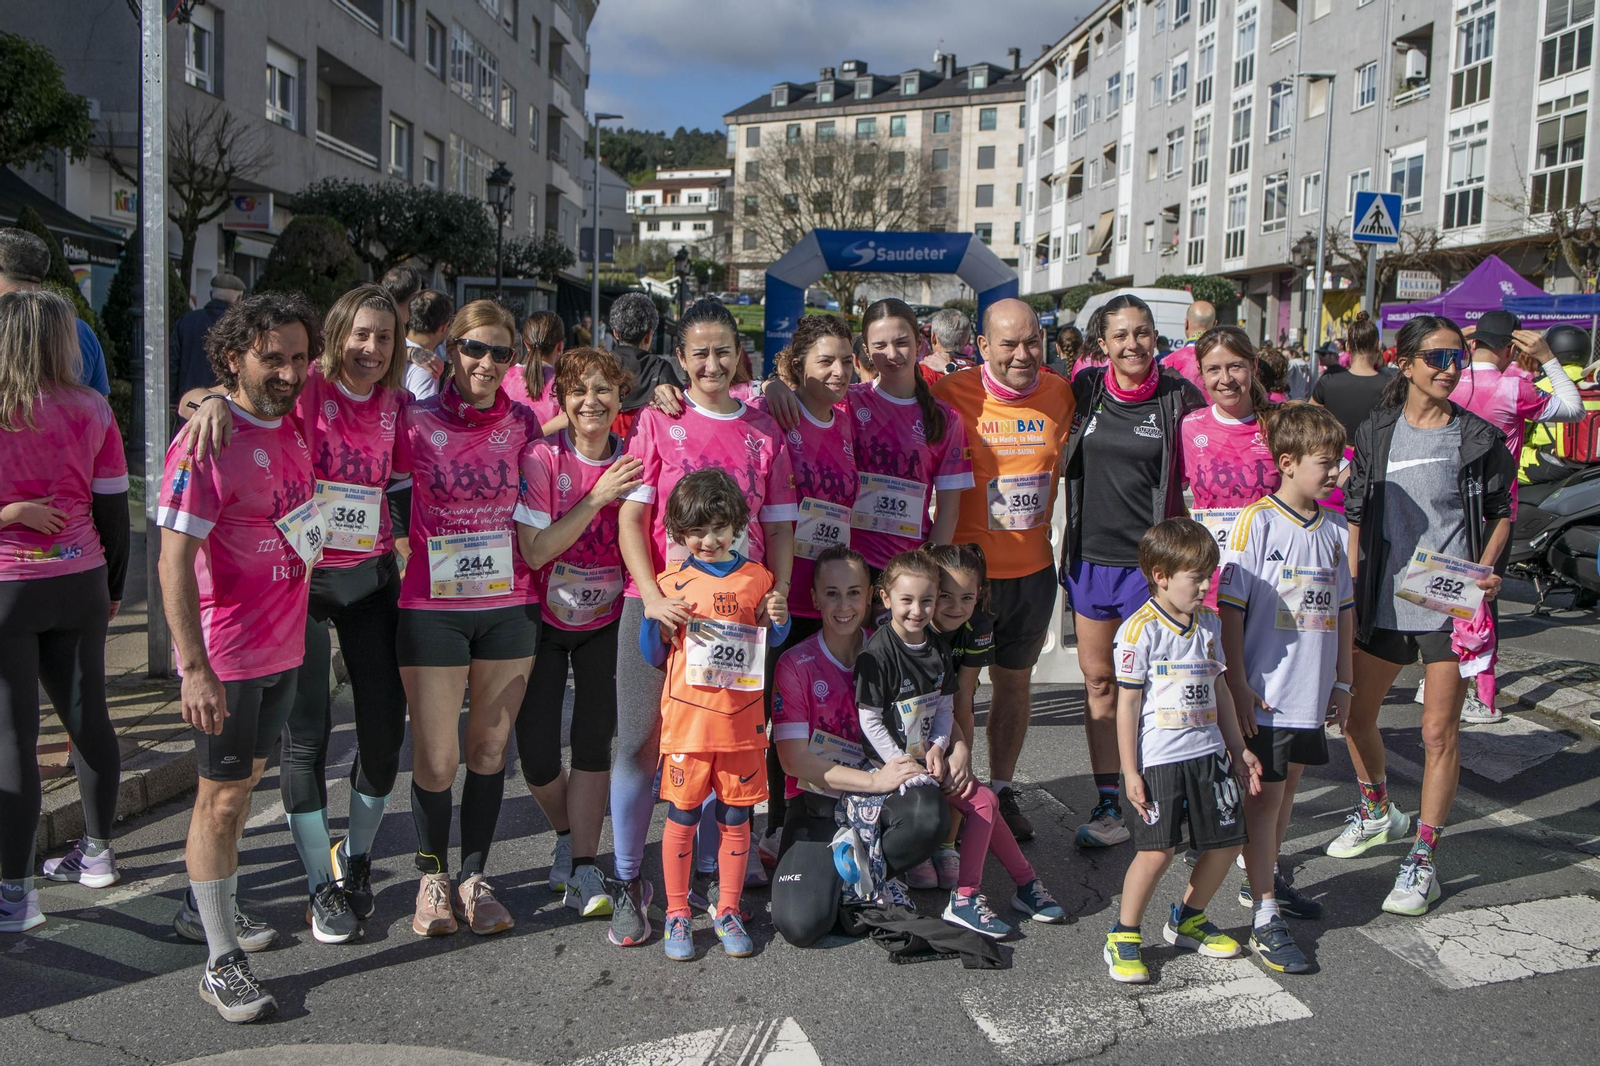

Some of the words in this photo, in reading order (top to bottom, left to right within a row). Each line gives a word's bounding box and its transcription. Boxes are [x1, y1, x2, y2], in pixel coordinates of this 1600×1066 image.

[876, 246, 947, 261] Saudeter
[766, 329, 792, 338] Saudete
[981, 419, 1045, 434] MINIBAY
[880, 496, 907, 512] 319
[1012, 493, 1039, 507] 306
[335, 507, 366, 524] 368
[440, 507, 474, 517] Carreira
[475, 504, 492, 518] pola
[495, 502, 515, 514] igual
[306, 525, 322, 546] 369
[817, 523, 840, 539] 318
[256, 538, 279, 553] III
[459, 555, 493, 572] 244
[1431, 577, 1465, 595] 252
[581, 589, 602, 602] 97
[1305, 591, 1331, 606] 360
[713, 644, 745, 663] 296
[1185, 684, 1210, 700] 359
[778, 873, 802, 883] NIKE
